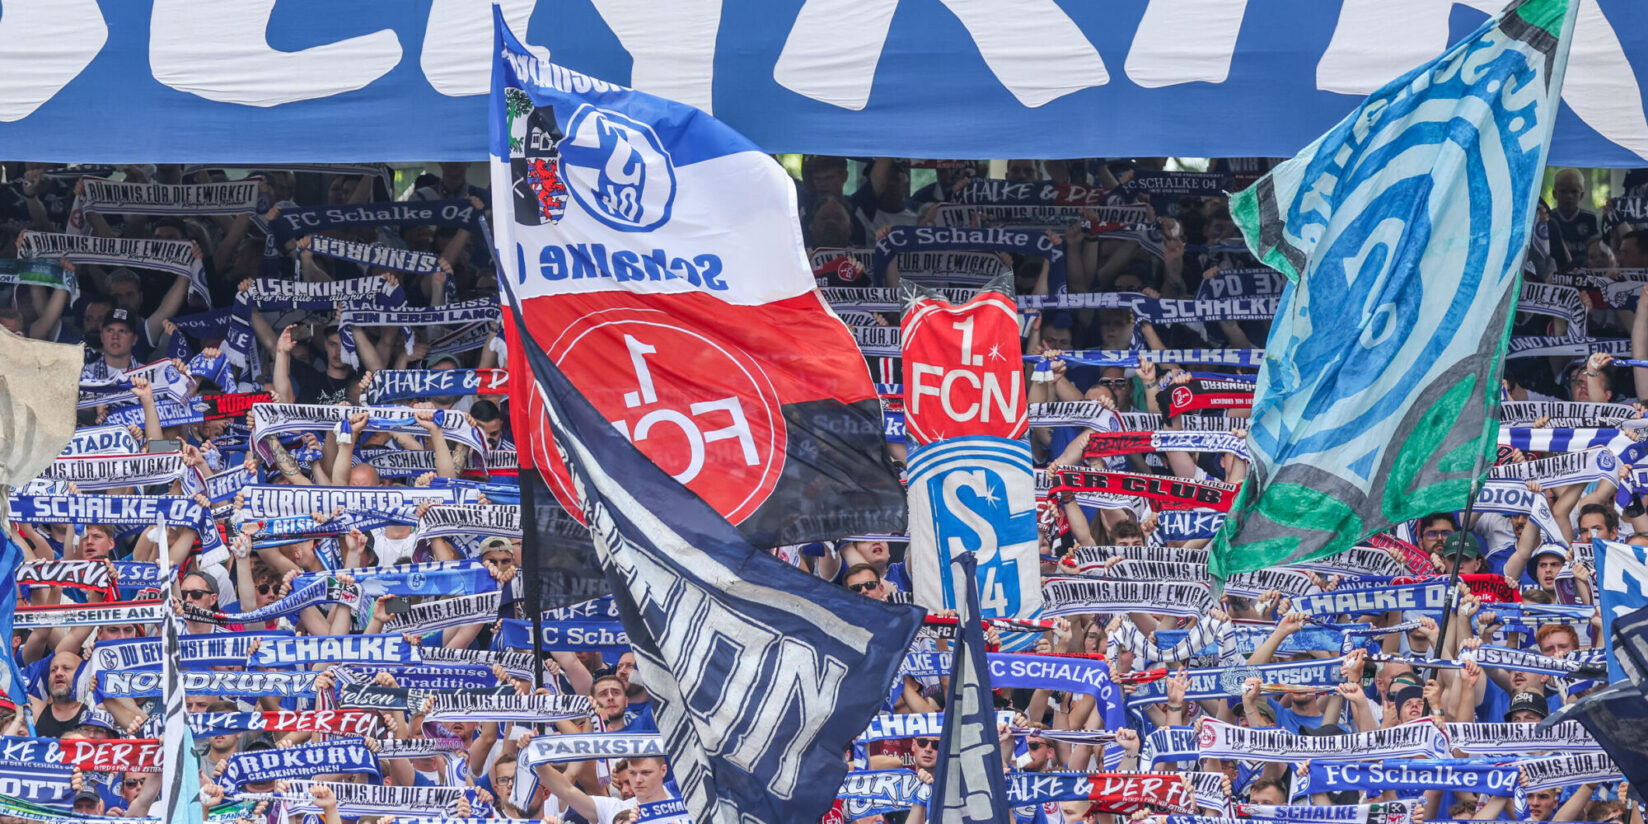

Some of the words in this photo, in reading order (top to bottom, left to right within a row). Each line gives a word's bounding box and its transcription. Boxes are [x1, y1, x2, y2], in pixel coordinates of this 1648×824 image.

[175, 184, 192, 203] DIE
[196, 184, 255, 202] EWIGKEIT
[963, 182, 1031, 203] HALKE
[1139, 179, 1199, 189] SCHALKE
[1203, 178, 1216, 189] 04
[283, 212, 321, 230] FC
[326, 206, 432, 222] Schalke
[441, 205, 475, 222] 04
[1100, 207, 1148, 223] WIGKEIT
[33, 232, 89, 253] BÜNDNIS
[120, 239, 140, 254] DIE
[876, 230, 908, 255] FC
[915, 228, 1029, 247] Schalke
[352, 313, 381, 323] EIN
[385, 312, 440, 325] LEBEN
[953, 316, 984, 366] 1.
[463, 374, 482, 388] &
[912, 362, 1020, 423] FCN
[1038, 402, 1106, 418] EWIGKEIT
[1501, 403, 1537, 421] NDNIS
[1570, 403, 1588, 419] DIE
[71, 459, 96, 476] FÜR
[100, 459, 120, 475] DIE
[123, 456, 182, 475] EWIGKEIT
[1505, 465, 1523, 479] DIE
[1528, 453, 1588, 475] EWIGKEIT
[1122, 477, 1222, 504] CLUB
[1478, 487, 1536, 508] DION
[34, 500, 158, 518] SCHALKE
[169, 501, 200, 523] 04
[251, 488, 404, 519] EUROFIGHTER
[273, 519, 315, 533] GELSE
[1158, 513, 1226, 536] HALKE
[1131, 562, 1190, 580] BÜNDNIS
[1053, 580, 1110, 603] BÜNDNIS
[1114, 582, 1139, 602] FÜR
[1143, 583, 1164, 602] DIE
[1294, 587, 1416, 615] CHALKE
[78, 608, 121, 621] SEITE
[127, 608, 149, 618] AN
[446, 599, 470, 616] FÜR
[477, 594, 497, 612] DIE
[567, 627, 631, 645] Scha
[119, 644, 139, 666] DU
[209, 639, 226, 657] NIE
[259, 636, 401, 664] SCHALKE
[1473, 649, 1581, 672] USWÄRTS
[1010, 660, 1110, 691] SCHALKE
[1265, 666, 1326, 684] FCS04
[433, 694, 493, 711] BÜNDNIS
[499, 694, 525, 710] FÜR
[529, 695, 549, 710] DIE
[248, 712, 267, 729] &
[274, 711, 332, 730] DER
[1225, 728, 1245, 745] EIN
[1250, 730, 1307, 750] BÜNDNIS
[1312, 734, 1334, 750] FÜR
[1342, 733, 1362, 749] DIE
[1367, 725, 1430, 746] EWIGKEIT
[1464, 723, 1523, 740] BÜNDNIS
[1559, 723, 1579, 739] DIE
[535, 740, 667, 756] PARKSTA
[1152, 733, 1168, 752] DU
[45, 742, 66, 763] &
[72, 742, 133, 766] DER
[1567, 754, 1591, 772] FÜR
[223, 745, 375, 792] NORDKURV
[248, 765, 340, 781] GELSENKIRCHEN
[1325, 764, 1361, 785] FC
[1369, 763, 1479, 787] Schalke
[1487, 769, 1517, 791] 04
[373, 786, 397, 801] FÜR
[401, 787, 423, 805] DIE
[1073, 777, 1094, 794] &
[1101, 778, 1163, 797] DER
[653, 802, 687, 816] SCHA
[1275, 805, 1358, 821] SCHALKE
